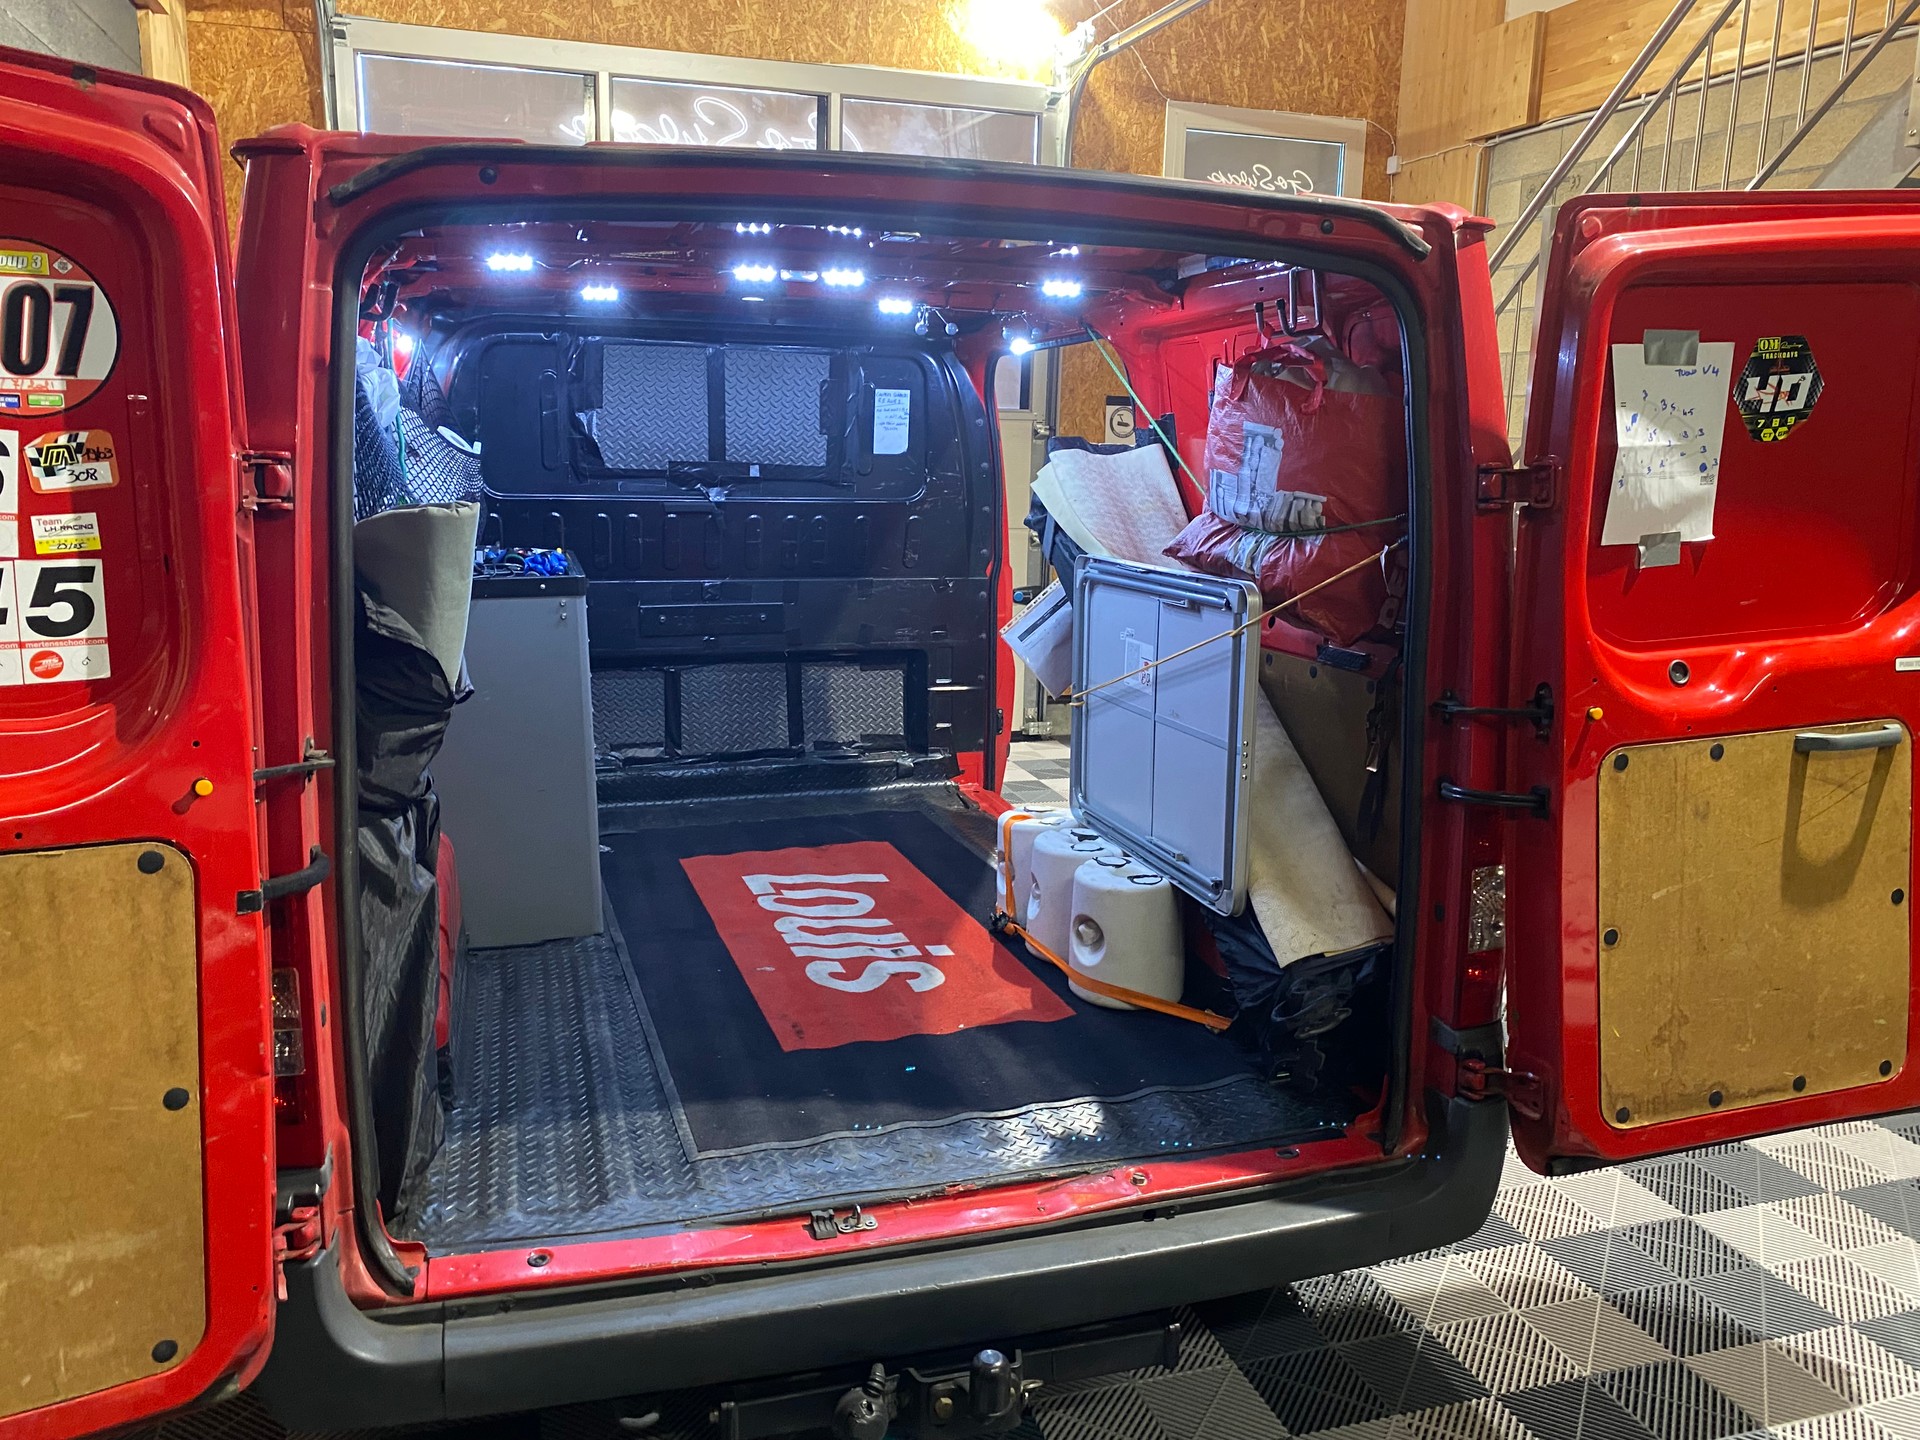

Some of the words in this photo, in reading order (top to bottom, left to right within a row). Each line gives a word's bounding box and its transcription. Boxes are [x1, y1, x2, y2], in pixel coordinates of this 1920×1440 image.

[31, 254, 42, 269] 3
[1760, 339, 1780, 351] OM
[1762, 351, 1798, 360] TRACKDAYS
[1758, 419, 1766, 428] 7
[1772, 418, 1780, 428] 8
[1787, 416, 1796, 425] 9
[36, 517, 62, 527] Team
[60, 523, 94, 532] RACING
[25, 565, 96, 637] 5
[25, 638, 106, 649] mertensschool.com
[740, 872, 956, 994] Louis
